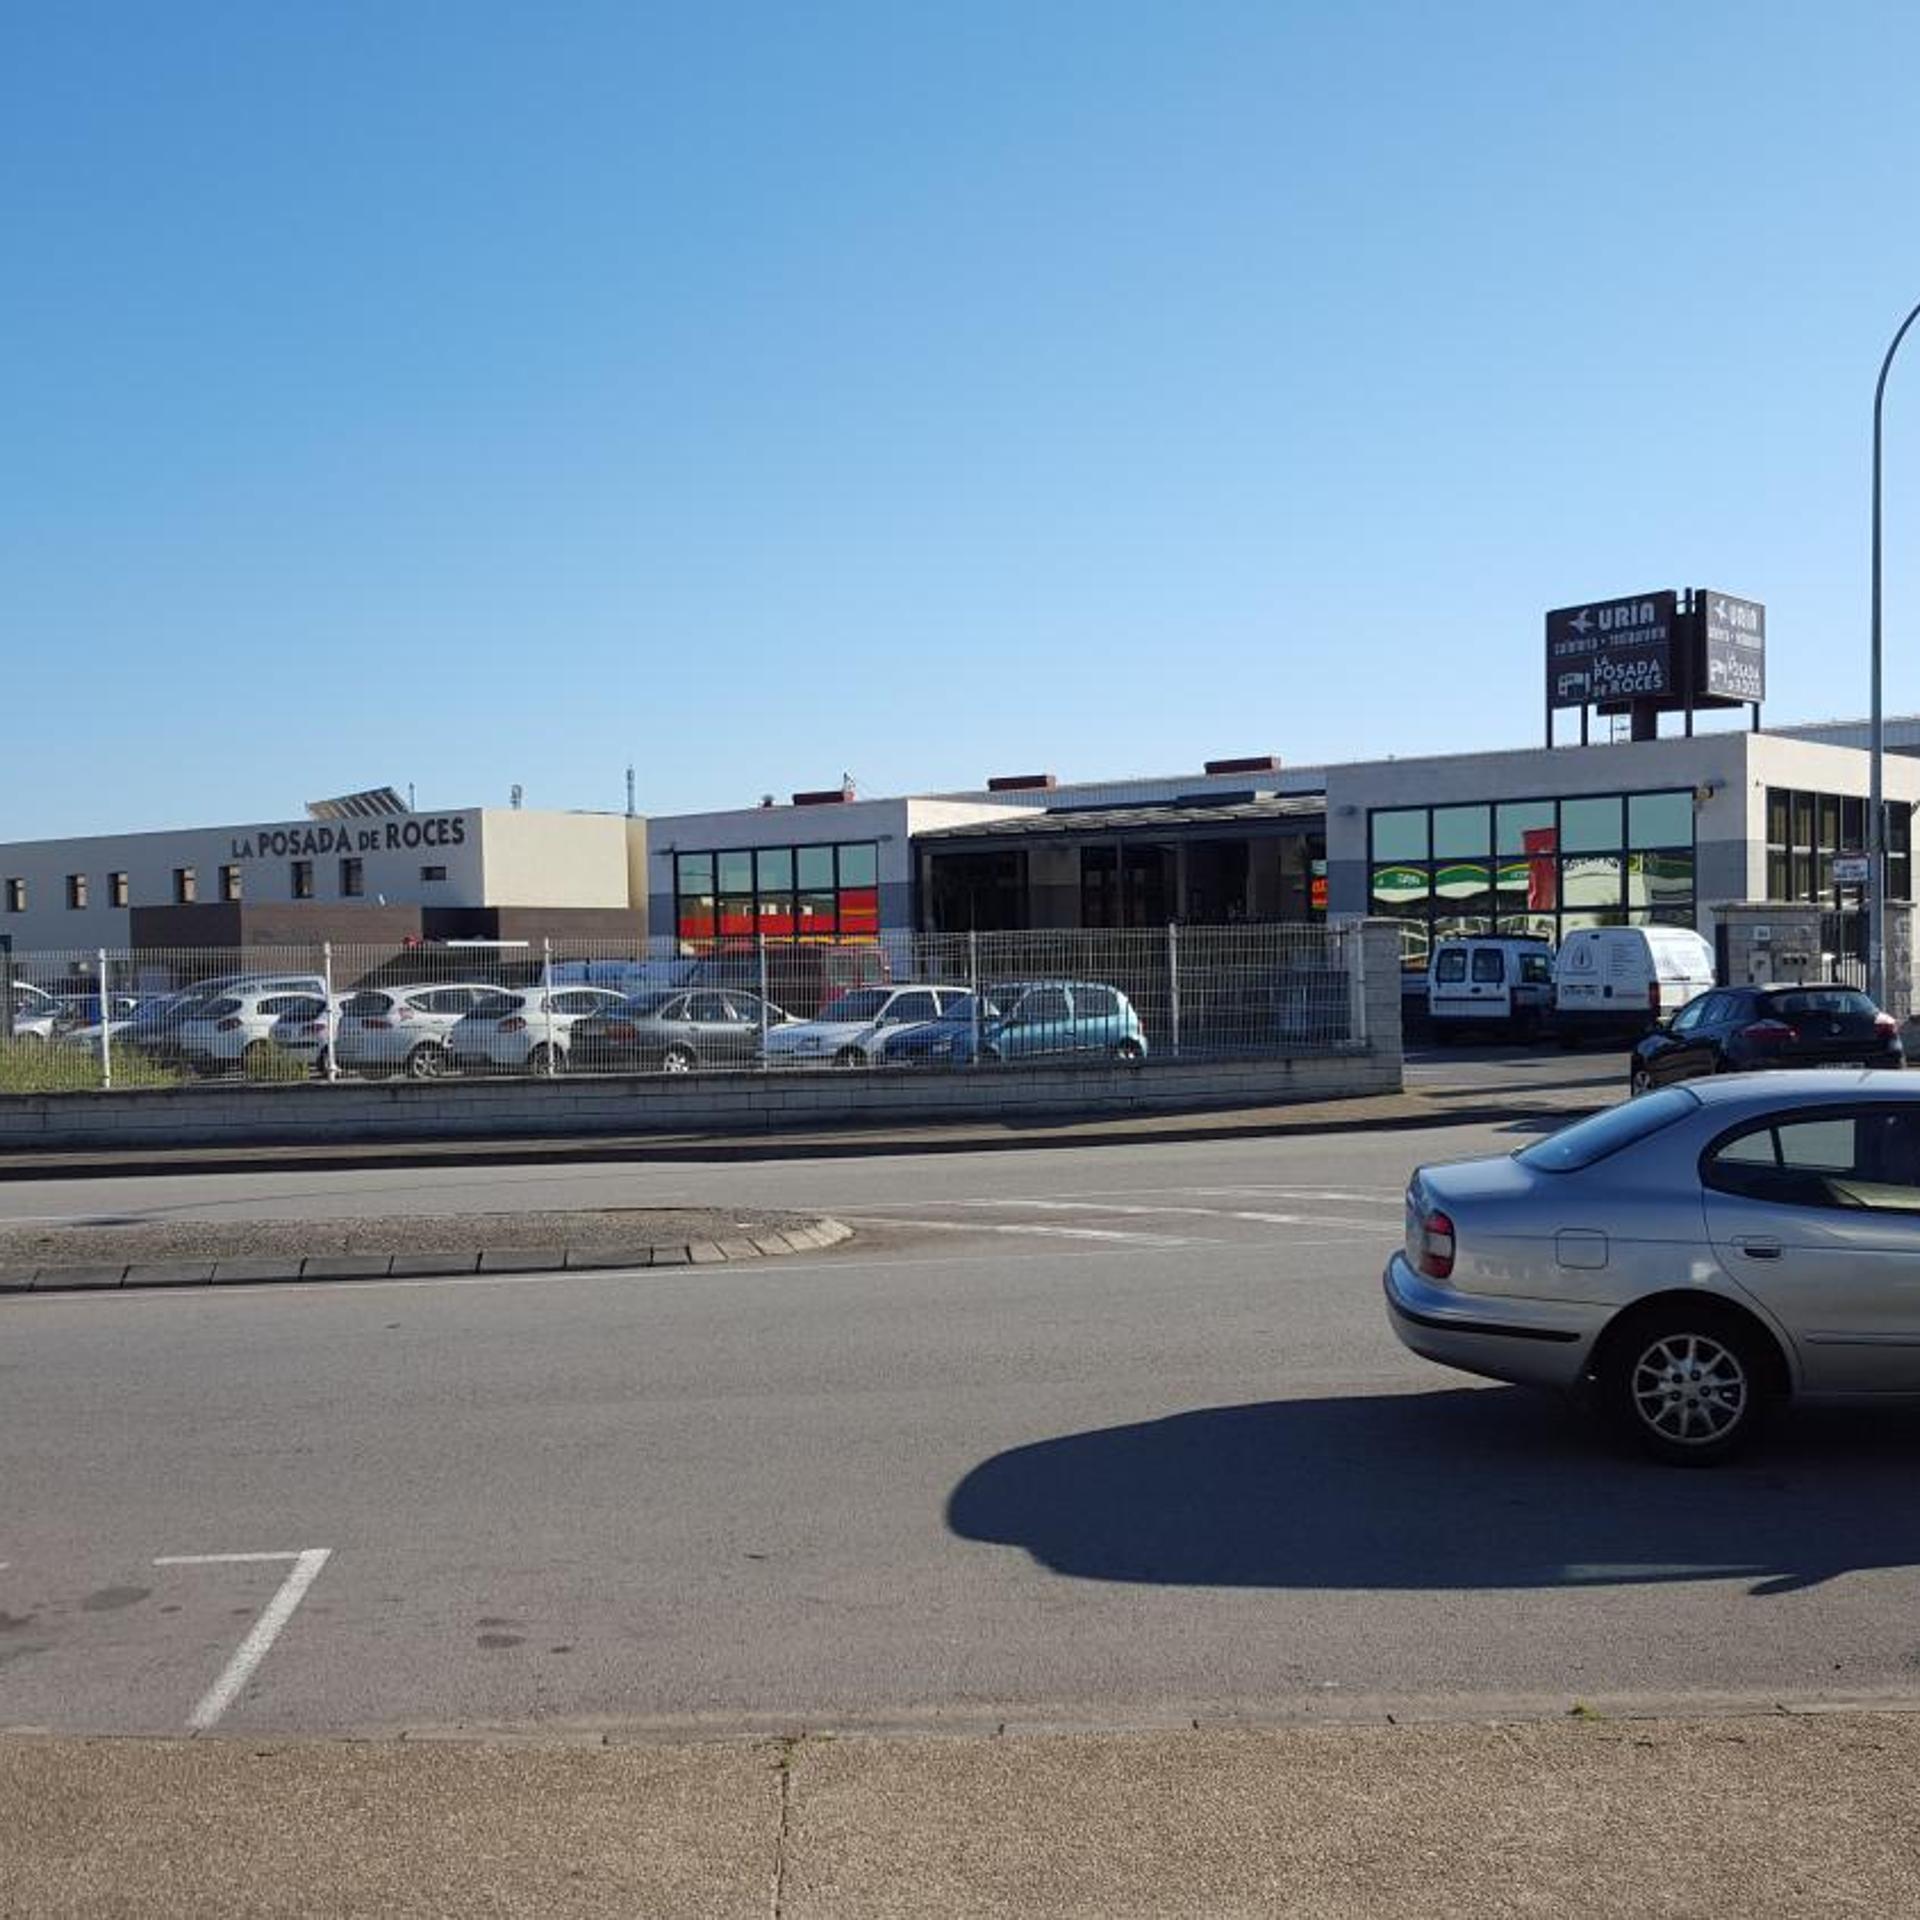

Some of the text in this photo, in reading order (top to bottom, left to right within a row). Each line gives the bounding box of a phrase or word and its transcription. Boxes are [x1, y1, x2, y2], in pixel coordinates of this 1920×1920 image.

[1593, 658, 1660, 683] POSADA
[1610, 673, 1664, 695] ROCES
[231, 816, 466, 859] LA POSADA DE ROCES
